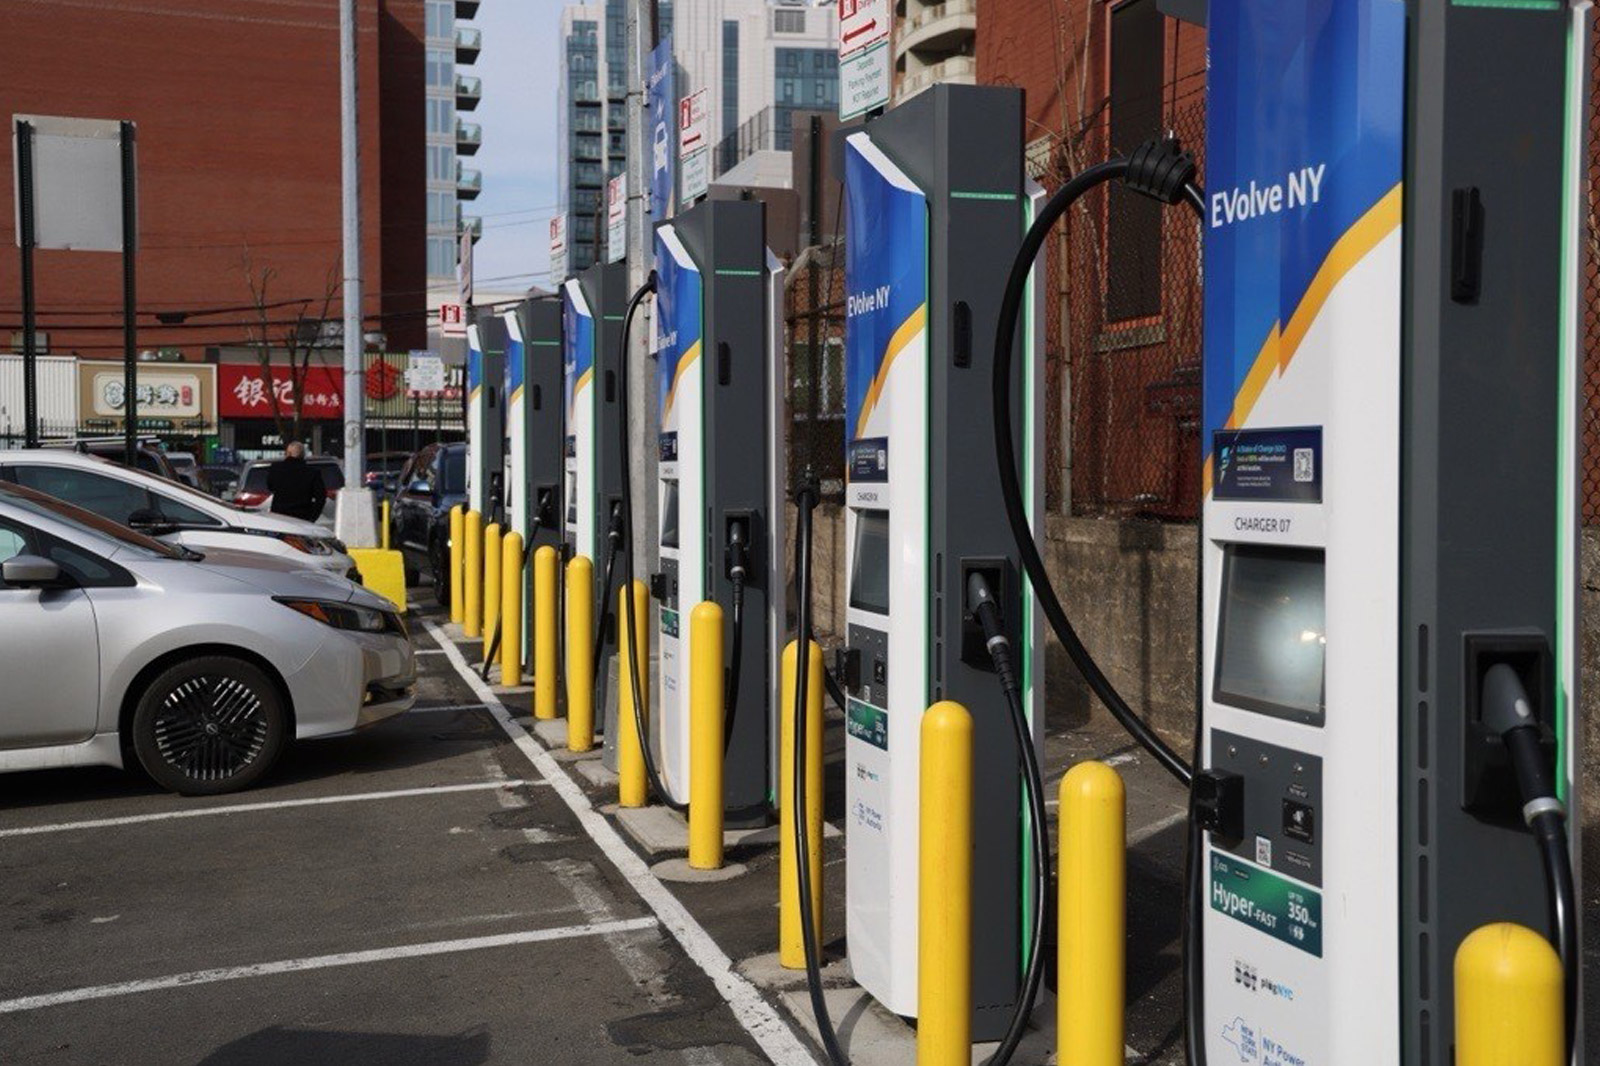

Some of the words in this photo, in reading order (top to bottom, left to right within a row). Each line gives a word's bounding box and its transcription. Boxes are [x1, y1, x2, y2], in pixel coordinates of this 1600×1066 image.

[1211, 180, 1282, 229] EVolve
[1288, 163, 1326, 209] NY
[848, 290, 875, 317] EVolve
[876, 285, 891, 310] NY
[1234, 517, 1278, 532] CHARGER
[1279, 518, 1292, 533] 07
[1287, 901, 1309, 925] 350
[1262, 1036, 1276, 1053] NY
